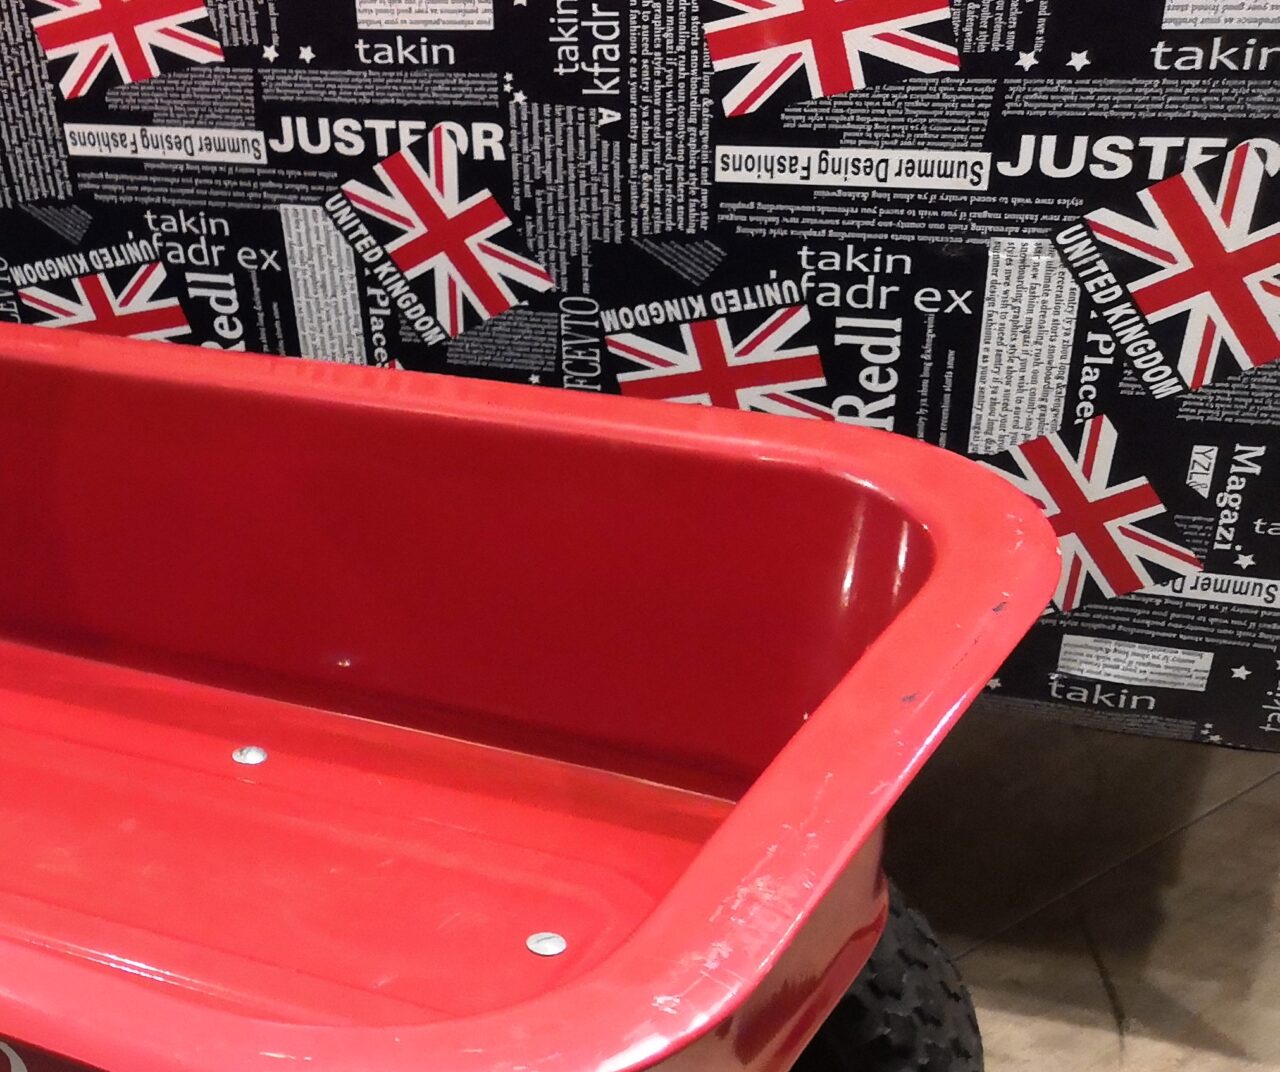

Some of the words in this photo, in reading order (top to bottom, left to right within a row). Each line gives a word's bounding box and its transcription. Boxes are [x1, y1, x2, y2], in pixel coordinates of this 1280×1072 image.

[548, 0, 579, 75] takin
[629, 9, 641, 54] fashions
[652, 2, 665, 48] graphics
[354, 35, 456, 65] takin
[652, 51, 665, 76] style
[664, 69, 673, 87] you
[678, 55, 690, 79] rush
[628, 82, 638, 105] your
[654, 80, 665, 106] show
[688, 49, 701, 124] snowboarding
[665, 90, 677, 115] wish
[70, 131, 138, 155] Fashions
[140, 128, 193, 156] Desing
[198, 136, 262, 160] Summer
[652, 141, 661, 164] your
[688, 127, 701, 170] graphics
[663, 163, 673, 181] you
[720, 153, 810, 180] Fashions
[817, 150, 889, 183] Desing
[895, 158, 984, 187] Summer
[996, 135, 1280, 181] JUSTF
[688, 172, 700, 196] style
[701, 166, 713, 185] and
[143, 208, 230, 237] takin
[89, 236, 158, 271] UNITED
[151, 232, 226, 267] fadr
[236, 246, 283, 271] ex
[797, 244, 913, 274] takin
[9, 253, 88, 287] KINGDOM
[324, 192, 382, 264] UNITED
[373, 259, 446, 347] KINGDOM
[710, 278, 801, 314] UNITED
[801, 271, 901, 310] fadr
[914, 286, 974, 314] ex
[600, 295, 707, 332] KINGDOM
[1056, 224, 1123, 304] UNITED
[1102, 301, 1184, 399] KINGDOM
[1039, 345, 1057, 403] snowboarding
[1213, 443, 1267, 551] Magazi
[1190, 576, 1278, 604] Summer
[1048, 680, 1156, 710] takin
